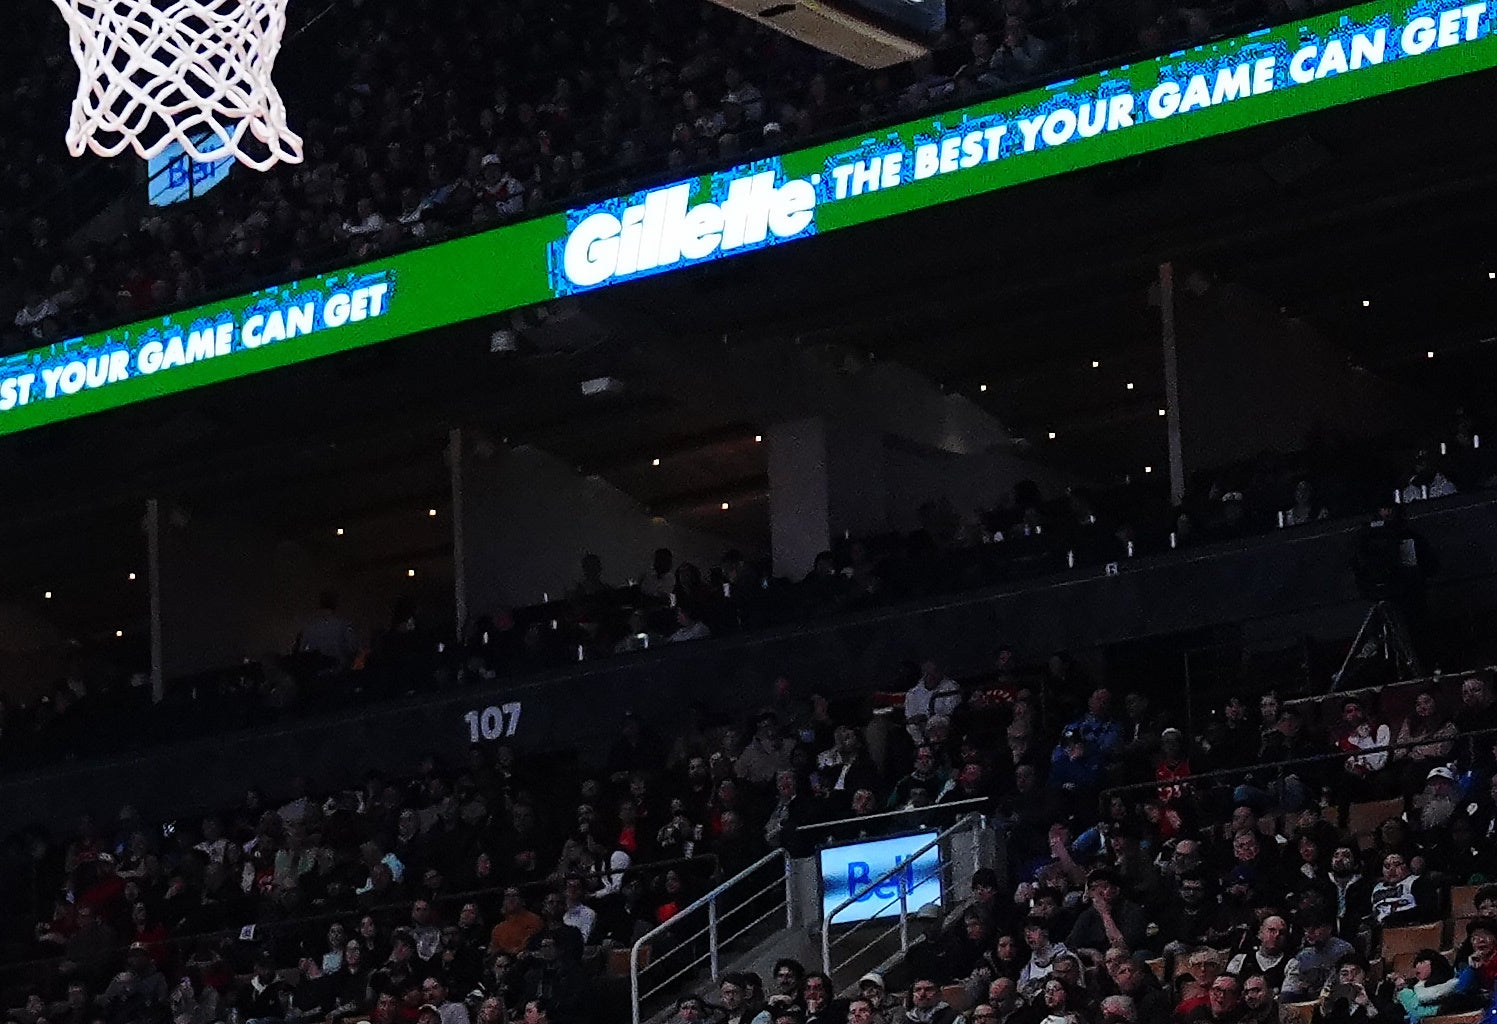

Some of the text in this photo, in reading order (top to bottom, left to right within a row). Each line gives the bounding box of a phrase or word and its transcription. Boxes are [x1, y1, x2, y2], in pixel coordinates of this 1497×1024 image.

[564, 2, 1488, 287] Gillette THE BEST YOUR GAME CAN GET
[42, 350, 131, 398] YOUR
[138, 322, 234, 374] GAME
[241, 302, 315, 348] CAN
[323, 283, 388, 328] GET
[464, 702, 522, 742] 107
[847, 854, 914, 902] Bell
